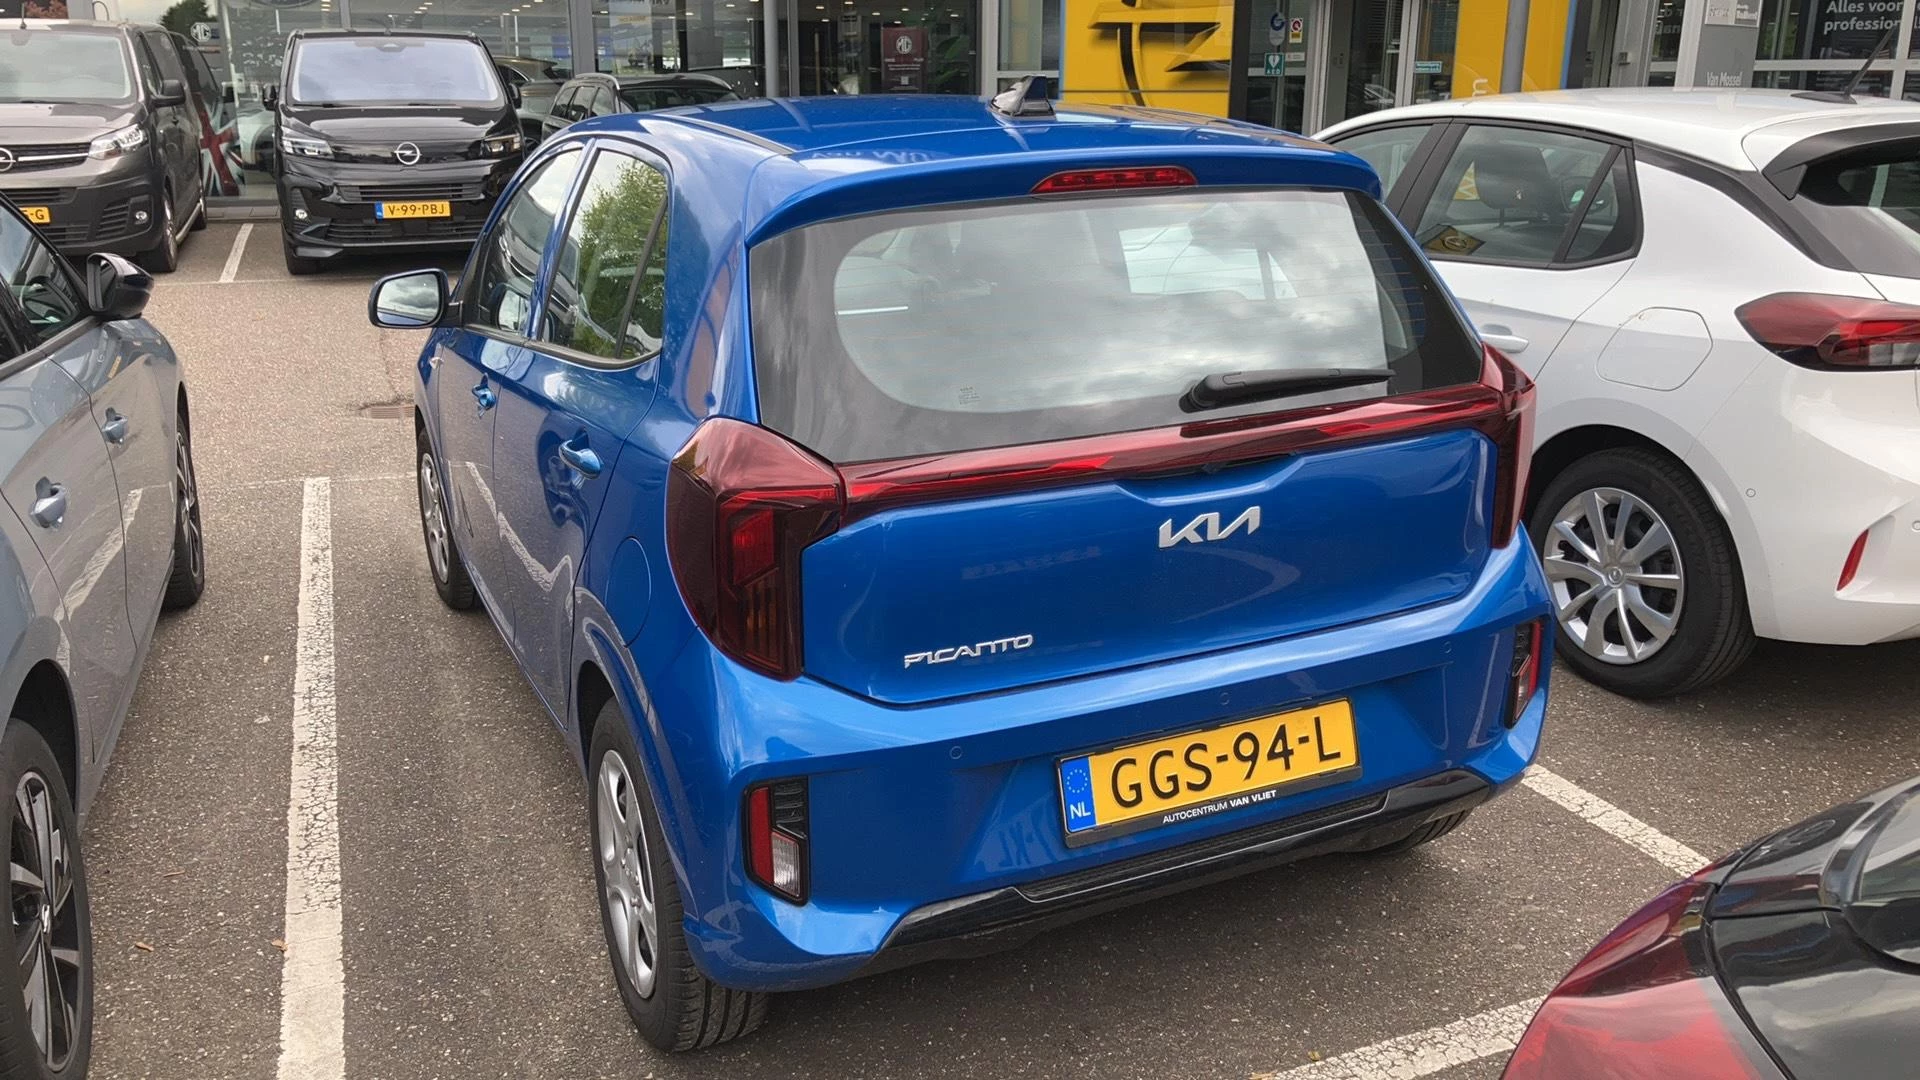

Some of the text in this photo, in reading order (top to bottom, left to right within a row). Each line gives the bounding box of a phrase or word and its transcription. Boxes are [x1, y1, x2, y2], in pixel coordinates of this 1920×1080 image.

[1825, 0, 1865, 14] Alles
[1868, 2, 1904, 12] voor
[190, 22, 212, 42] MG
[896, 36, 912, 54] MG
[1706, 71, 1743, 87] Van Mossel
[387, 203, 445, 216] V-99-PBJ
[1158, 505, 1261, 549] KIA
[903, 634, 1033, 669] PICANTO
[1110, 716, 1341, 809] GGS-94-L
[1070, 801, 1091, 820] NL
[1162, 790, 1277, 824] AUTOCENTRUM VAN VLIET
